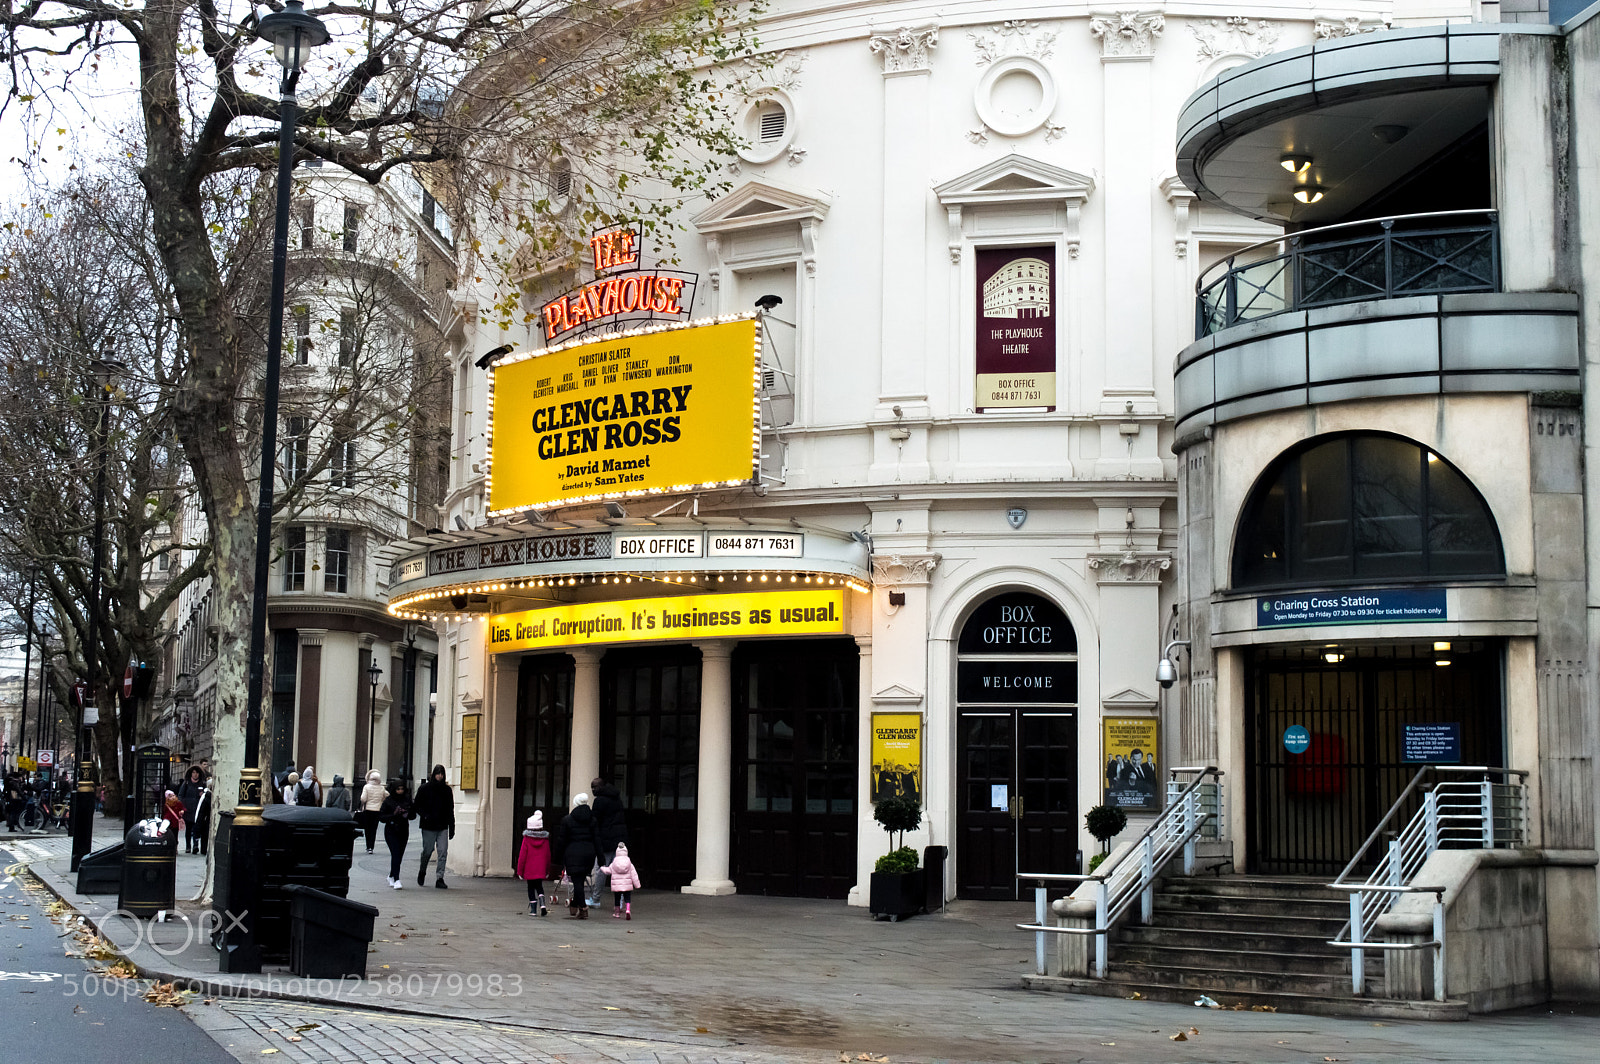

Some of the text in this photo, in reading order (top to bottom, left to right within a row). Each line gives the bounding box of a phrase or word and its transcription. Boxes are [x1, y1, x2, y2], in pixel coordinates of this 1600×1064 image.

[590, 228, 636, 270] THE
[544, 276, 684, 338] PLAYHOUSE
[991, 328, 1043, 340] THE PLAYHOUSE
[578, 348, 630, 366] CHRISTIAN SLATER
[1002, 344, 1030, 354] THEATRE
[536, 356, 680, 388] ROBERT KRIS DANIEL OLIVER STANLEY DON
[557, 381, 578, 393] MARSHALL
[584, 378, 596, 388] RYAN
[604, 374, 616, 384] RYAN
[622, 369, 651, 381] TOWNSEND
[656, 364, 692, 376] WARRINGTON
[998, 379, 1035, 389] BOX OFFICE
[992, 391, 1041, 400] 0844 871 7631
[532, 385, 692, 434] GLENGARRY
[538, 416, 681, 460] GLEN ROSS
[566, 461, 599, 477] David
[602, 455, 650, 473] Mamet
[562, 473, 644, 490] directed by Sam Yates
[620, 539, 695, 554] BOX OFFICE
[716, 538, 794, 550] 0844 871 7631
[436, 551, 466, 570] THE
[1274, 596, 1379, 611] Charing Cross Station
[492, 602, 839, 643] Lies. Greed. Corruption. It's business as usual.
[1001, 606, 1035, 622] BOX
[983, 627, 1052, 643] OFFICE
[983, 677, 1052, 688] WELCOME
